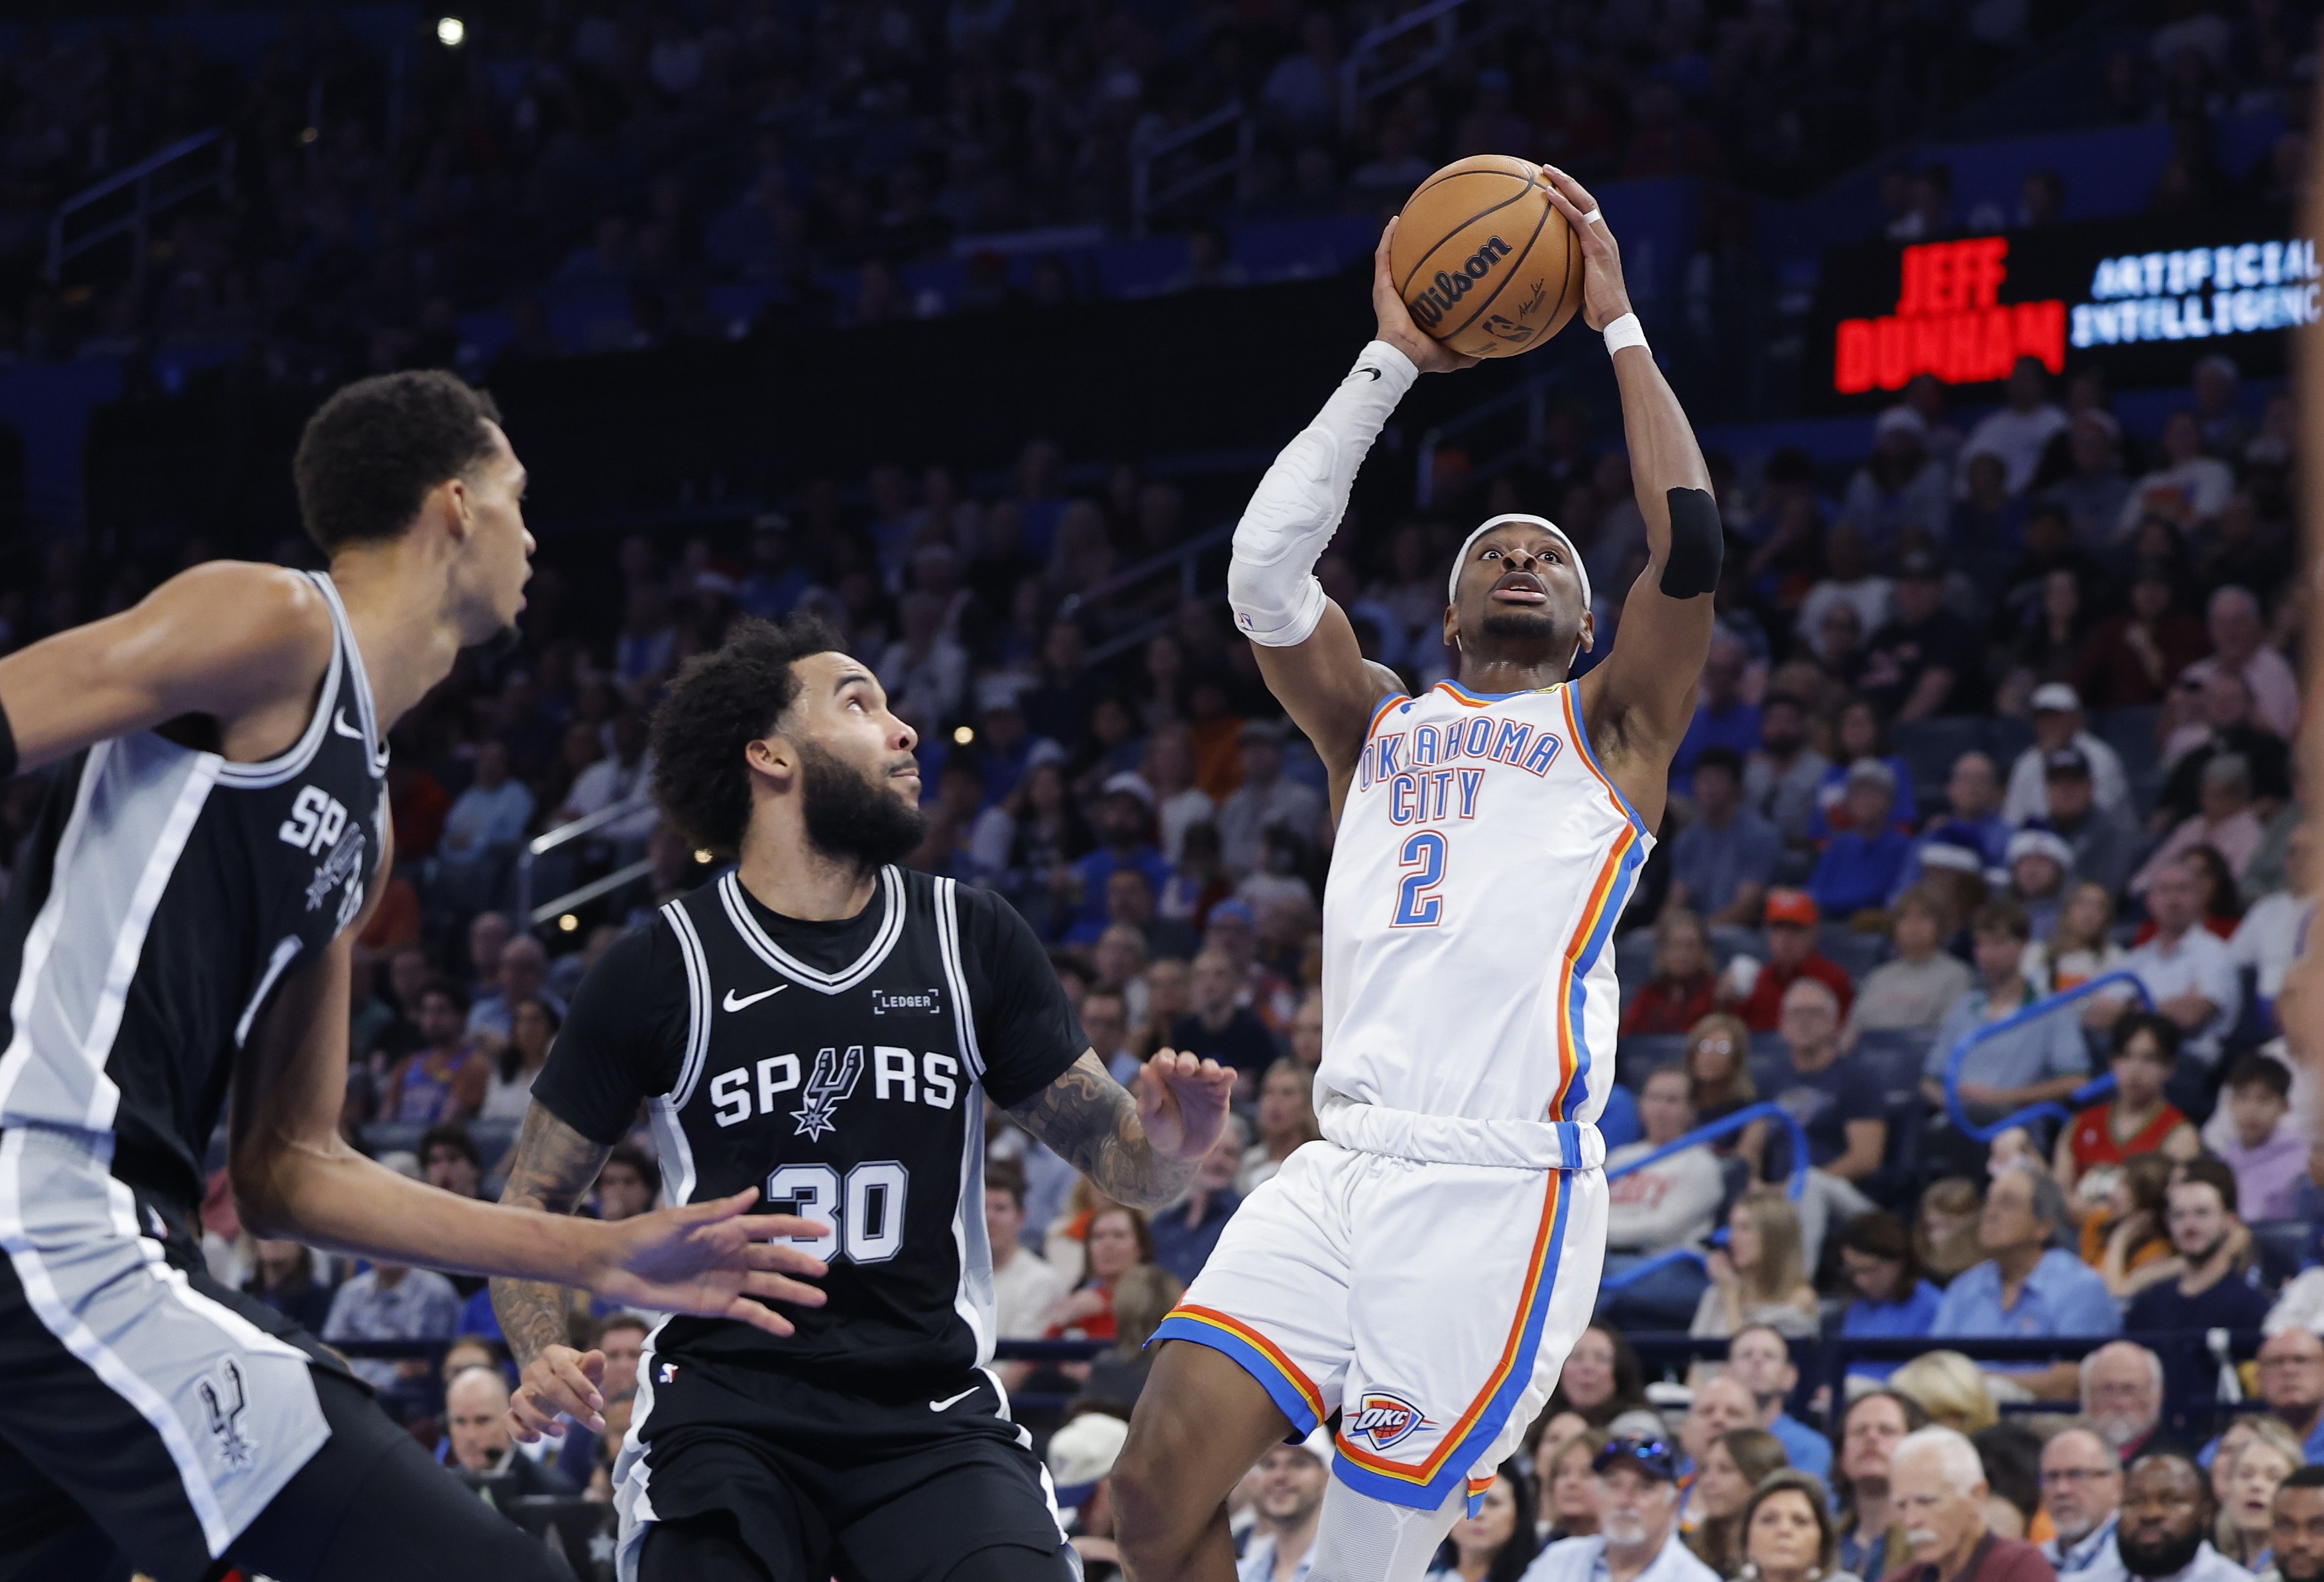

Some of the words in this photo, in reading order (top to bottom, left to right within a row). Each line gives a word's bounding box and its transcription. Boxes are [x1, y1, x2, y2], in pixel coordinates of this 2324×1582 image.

[1409, 235, 1513, 329] Wilson
[1895, 235, 2009, 317] JEFF
[2091, 238, 2322, 301] ARTIFICIAL
[1835, 299, 2066, 395] DUNHAM
[2070, 281, 2321, 349] INTELLIGENC
[1359, 716, 1563, 792] OKAHOMA
[1389, 767, 1486, 826] CITY
[1389, 829, 1447, 928] 2
[881, 996, 930, 1008] LEDGER
[710, 1045, 960, 1143] SPURS
[766, 1159, 910, 1265] 30
[1354, 1407, 1410, 1431] OKC
